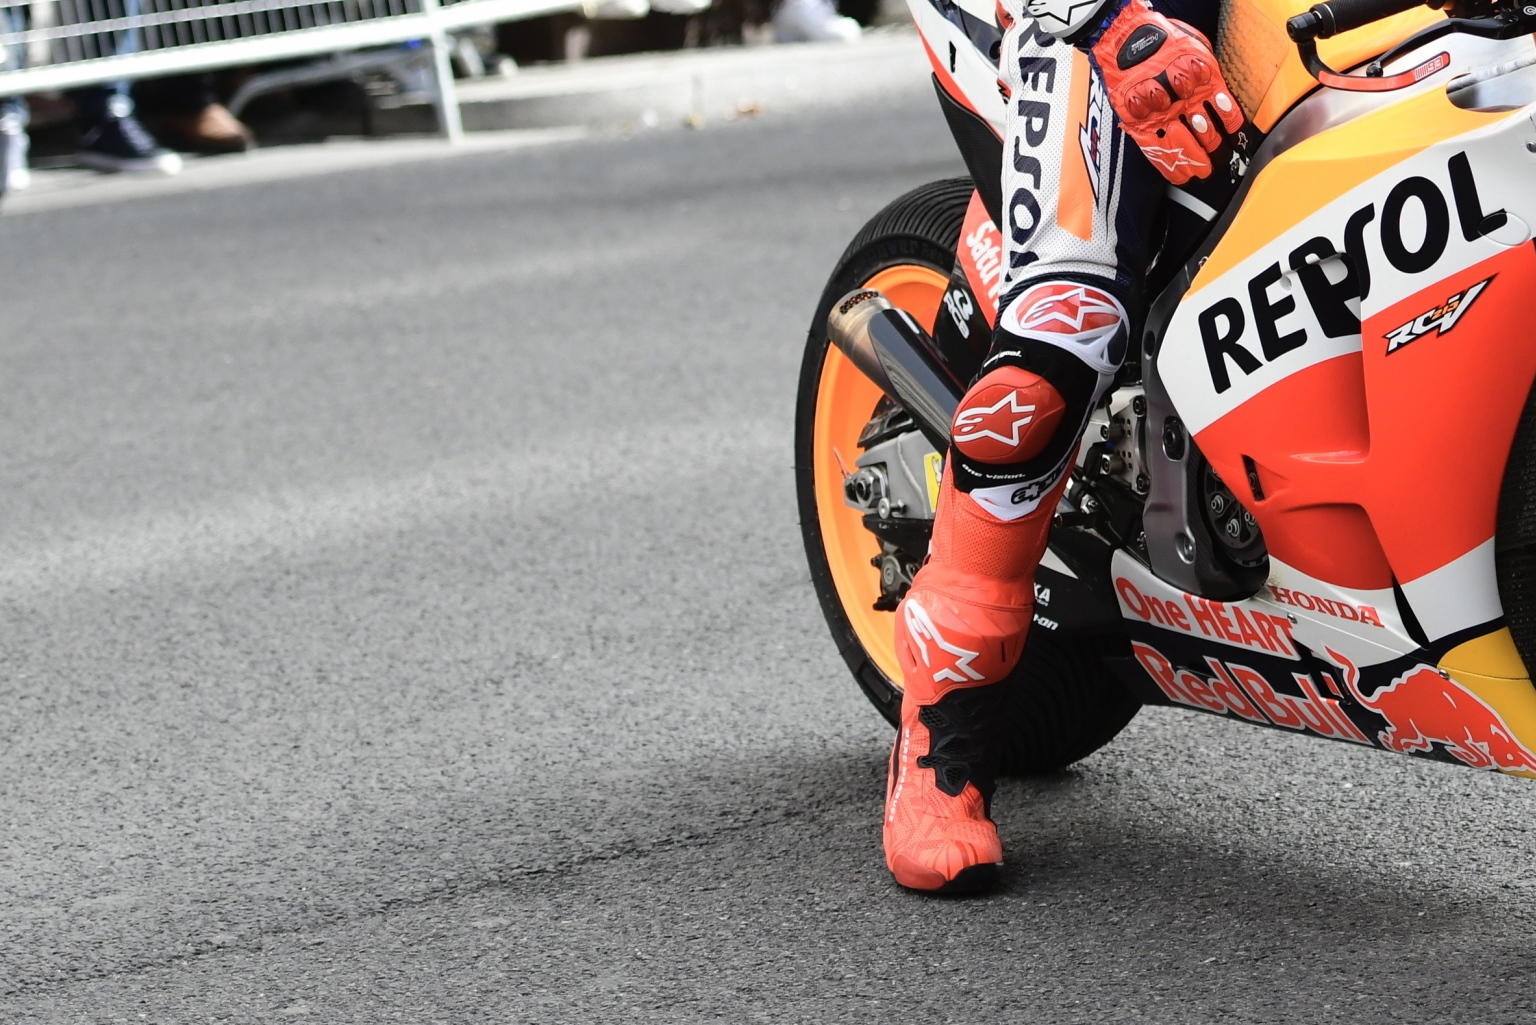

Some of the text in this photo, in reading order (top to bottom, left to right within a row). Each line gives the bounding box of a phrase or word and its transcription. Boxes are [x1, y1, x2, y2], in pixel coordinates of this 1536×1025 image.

[1198, 151, 1508, 394] REPSOL
[1115, 577, 1192, 632] One
[1183, 593, 1295, 657] HEART
[1269, 585, 1385, 628] HONDA
